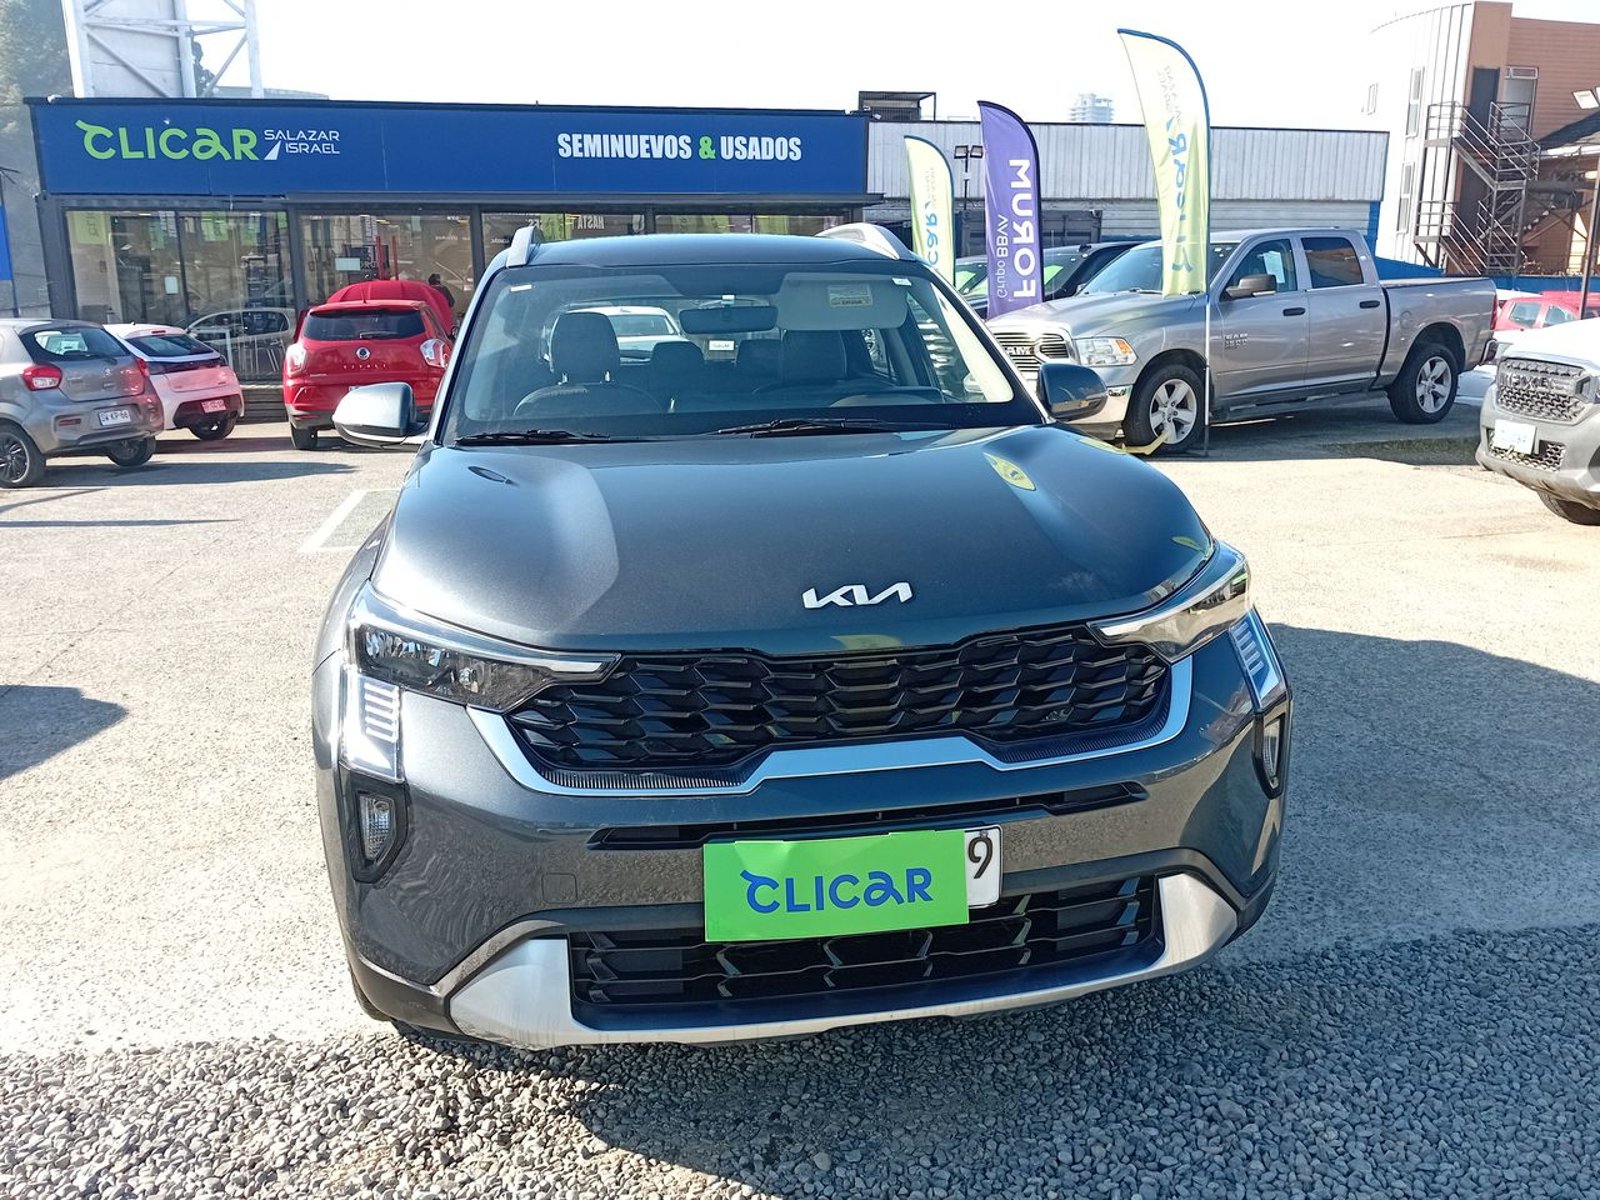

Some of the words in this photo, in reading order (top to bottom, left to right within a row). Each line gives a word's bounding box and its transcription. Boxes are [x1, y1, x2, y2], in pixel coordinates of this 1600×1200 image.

[264, 129, 340, 141] SALAZAR
[557, 133, 692, 159] SEMINUEVOS
[699, 136, 716, 159] &
[720, 136, 802, 161] USADOS
[285, 142, 340, 155] ISRAEL
[802, 582, 913, 608] KIA
[967, 836, 994, 880] 9
